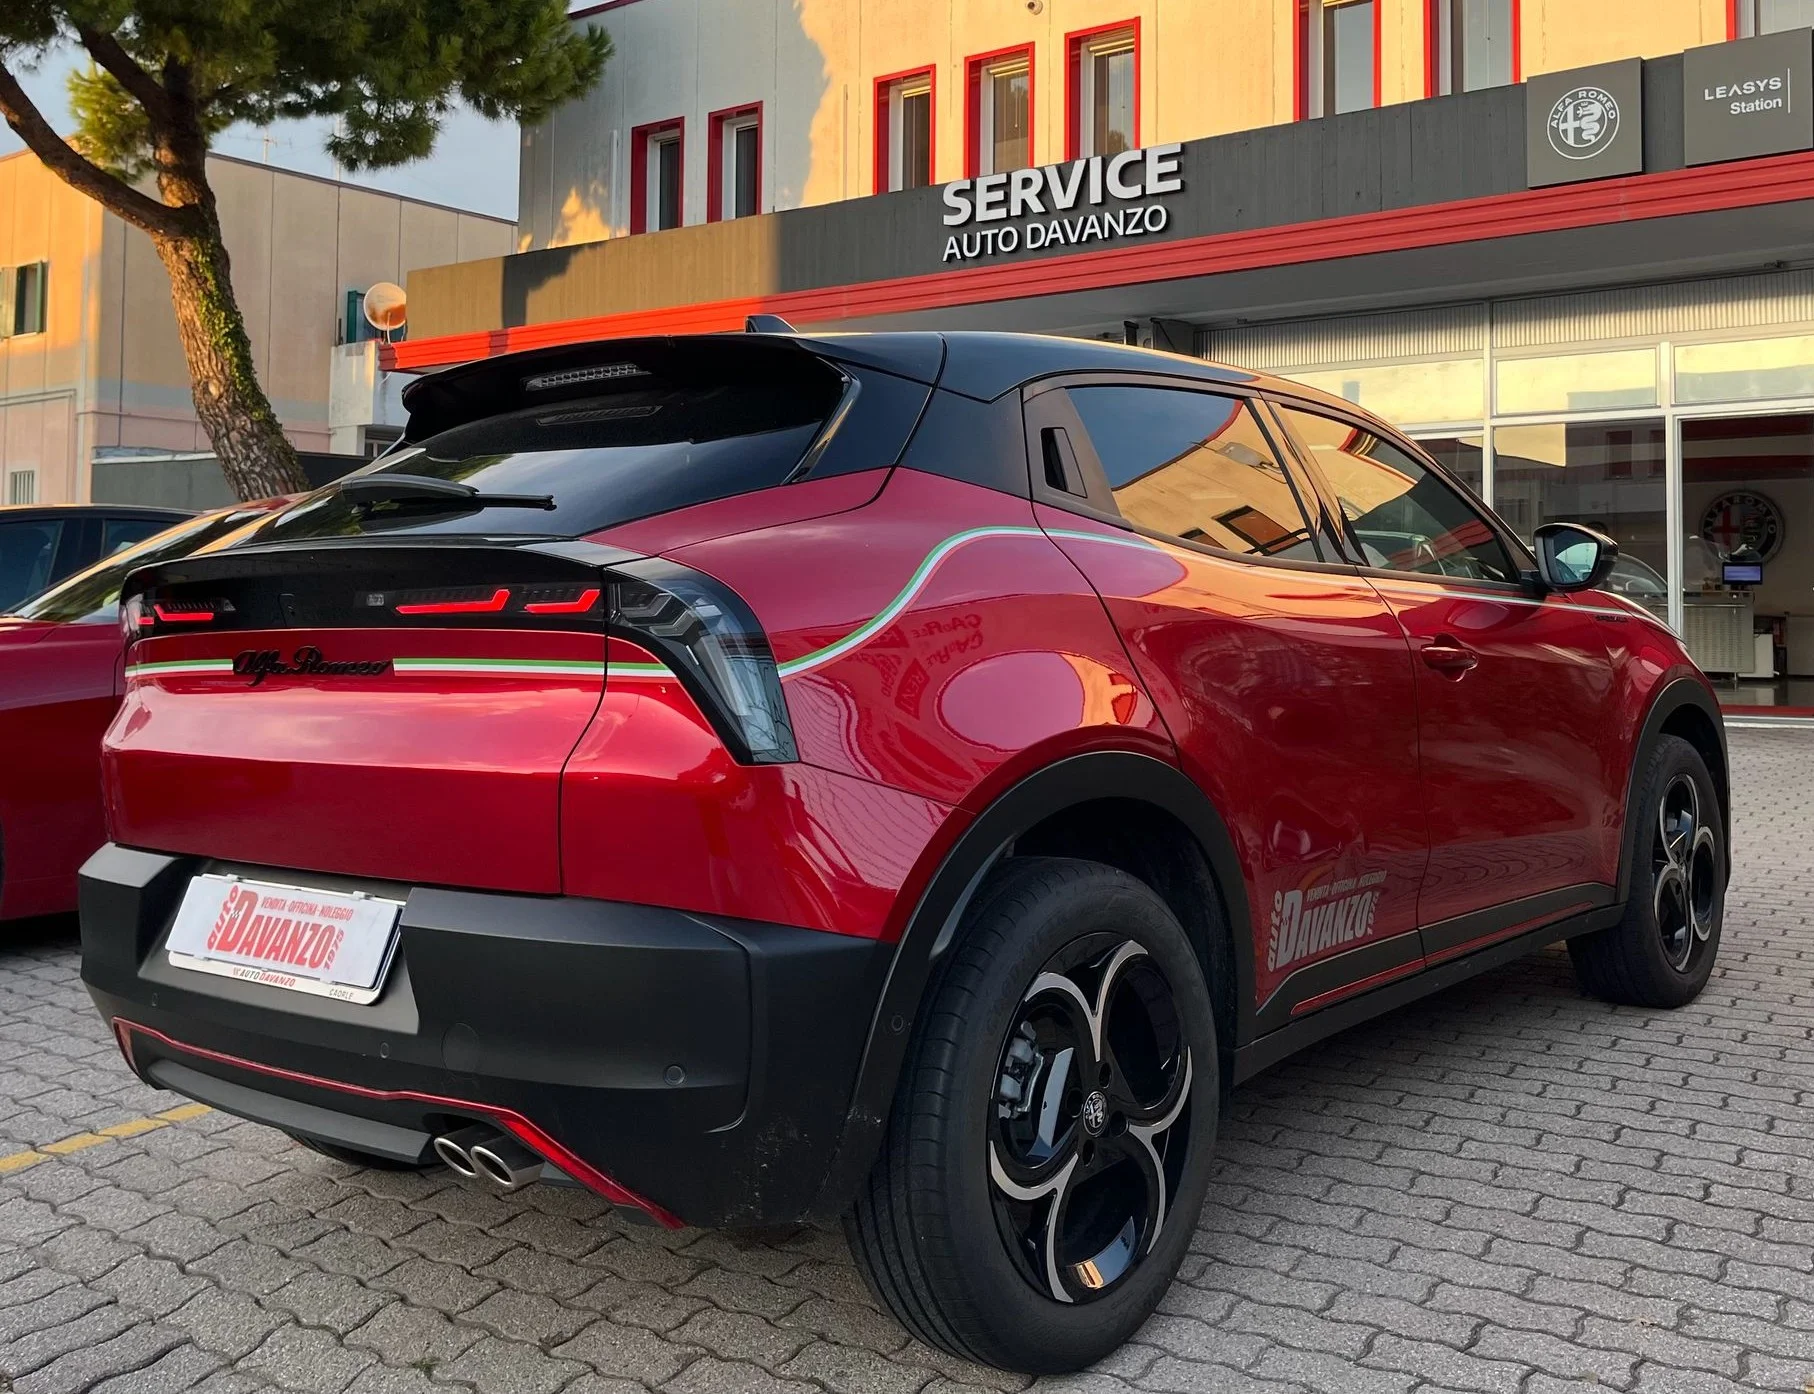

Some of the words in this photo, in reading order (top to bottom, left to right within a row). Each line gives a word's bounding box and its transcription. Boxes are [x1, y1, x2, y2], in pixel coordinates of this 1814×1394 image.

[1550, 97, 1573, 129] ALFA
[1577, 89, 1617, 121] ROMEO
[1729, 97, 1783, 115] Station
[942, 142, 1182, 227] SERVICE
[942, 226, 1019, 262] AUTO
[1025, 203, 1168, 250] DAVANZO
[233, 649, 289, 687] Alfa
[291, 644, 391, 675] Romeo
[216, 890, 336, 969] DAVANZO
[1276, 889, 1373, 969] DAVANZO
